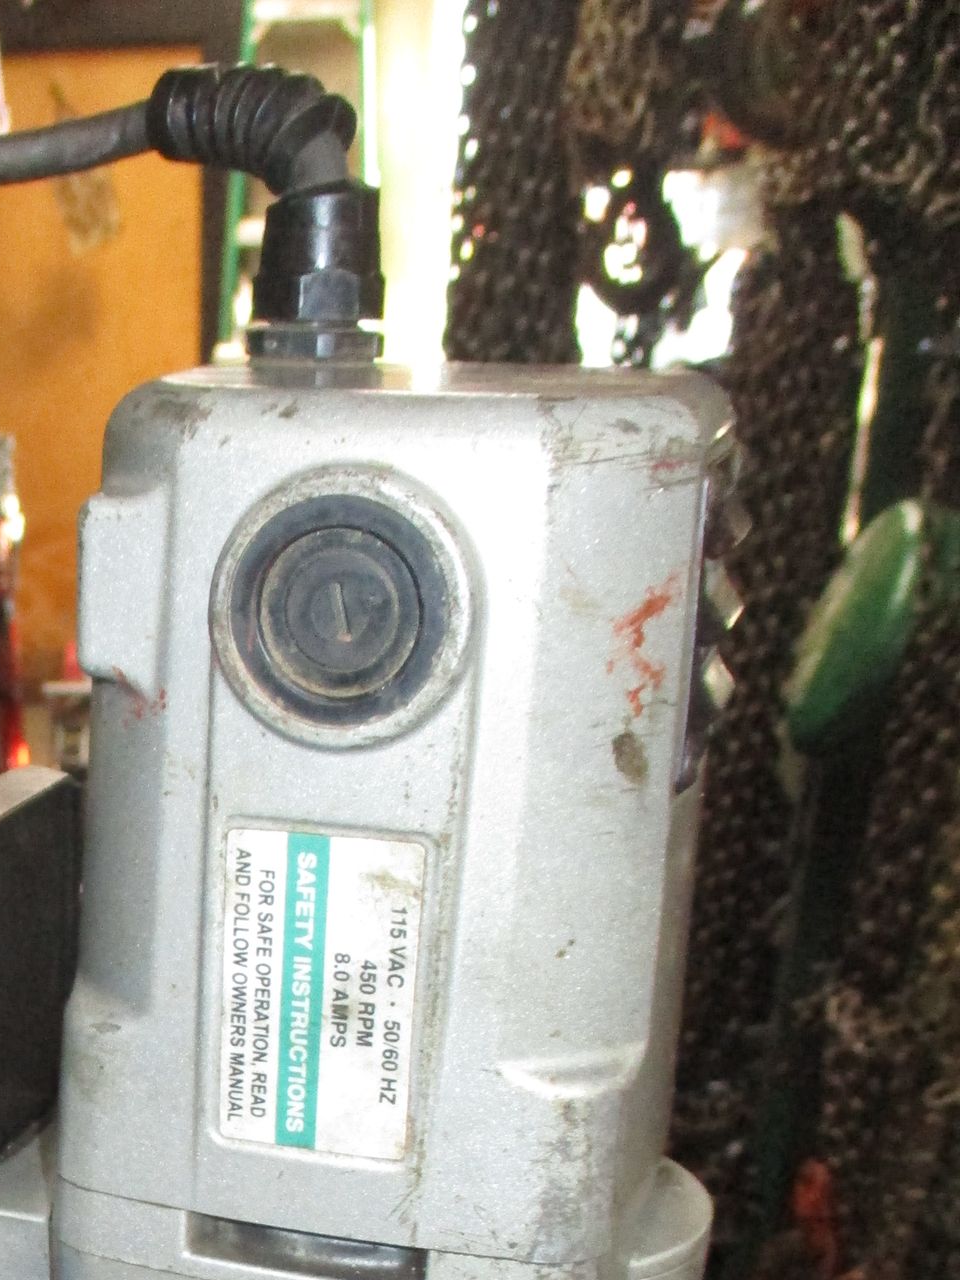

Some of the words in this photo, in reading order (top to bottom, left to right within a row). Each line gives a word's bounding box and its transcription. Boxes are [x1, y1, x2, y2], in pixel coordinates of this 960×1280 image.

[235, 847, 252, 886] AND
[258, 869, 275, 906] FOR
[294, 851, 318, 951] SAFETY
[390, 906, 408, 939] 115
[232, 892, 251, 968] FOLLOW
[255, 911, 274, 958] SAFE
[333, 952, 351, 982] 8.0
[358, 959, 377, 995] 450
[386, 946, 406, 989] VAC
[229, 972, 248, 1047] OWNERS
[250, 963, 272, 1066] OPERATION,
[330, 988, 349, 1048] AMPS
[356, 1001, 376, 1048] RPM
[285, 955, 312, 1133] INSTRUCTIONS
[381, 1019, 401, 1072] 50/60
[227, 1052, 245, 1121] MANUAL
[250, 1072, 268, 1118] READ
[379, 1077, 397, 1105] HZ
